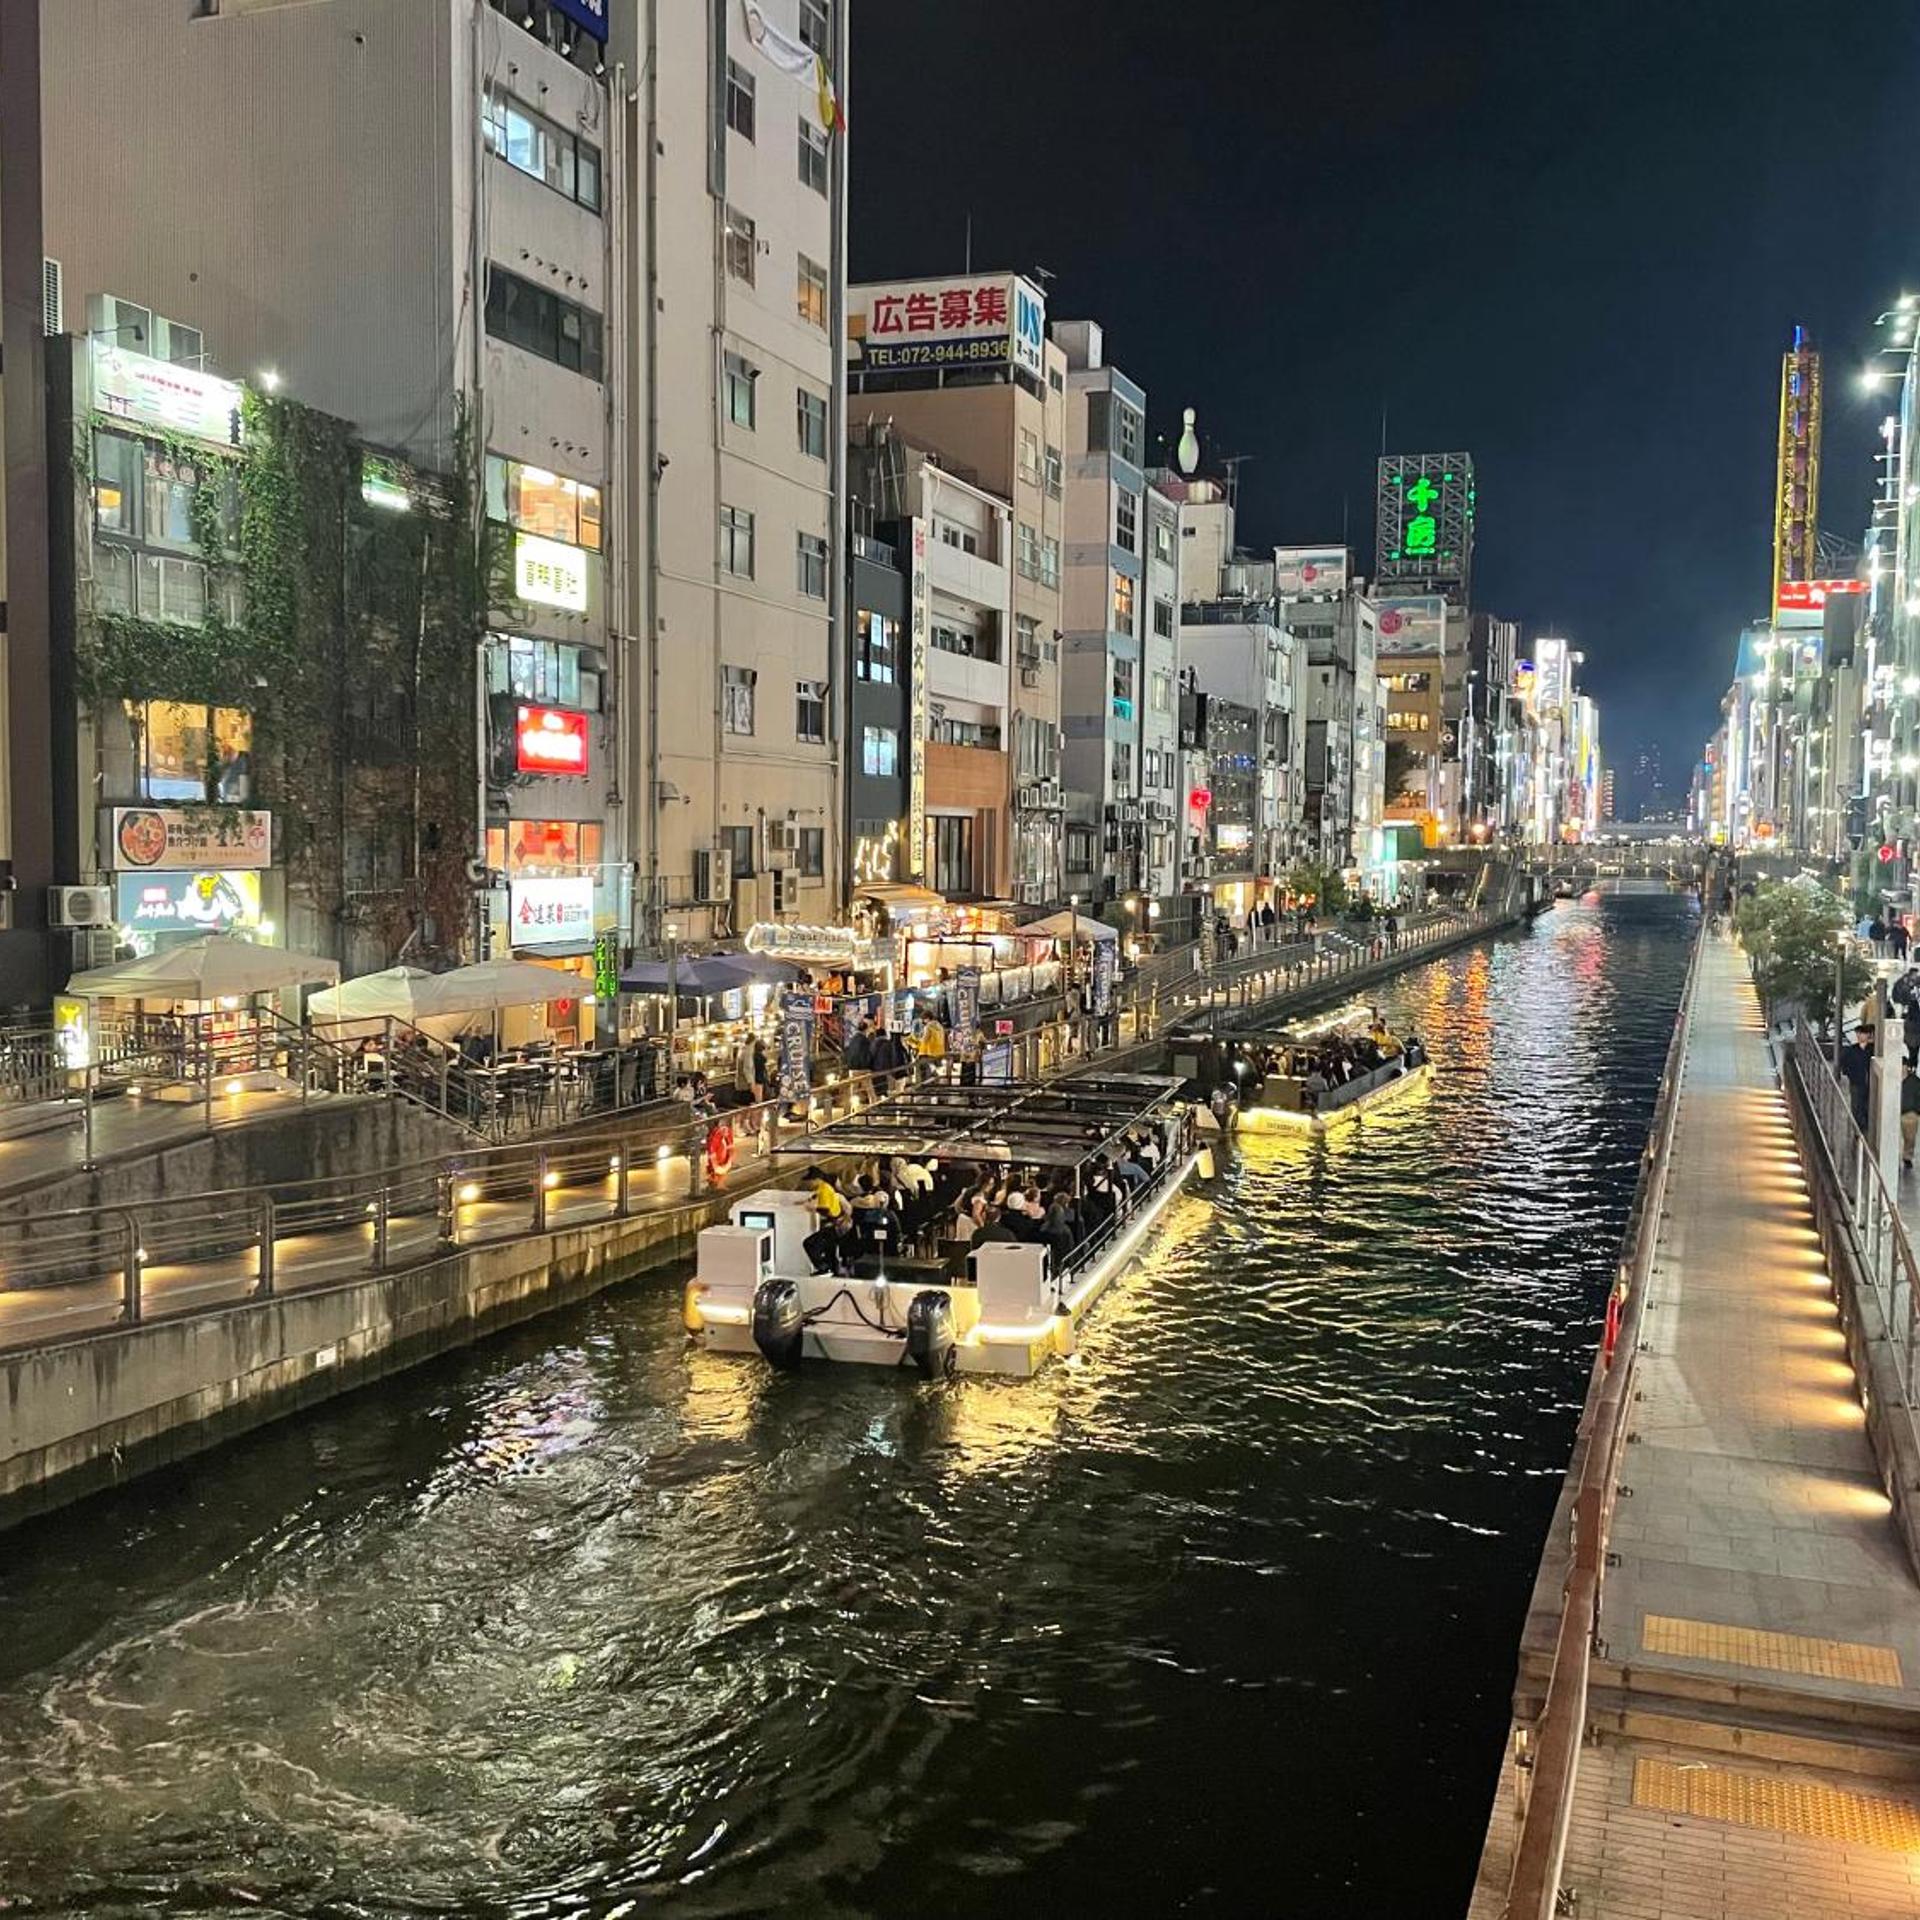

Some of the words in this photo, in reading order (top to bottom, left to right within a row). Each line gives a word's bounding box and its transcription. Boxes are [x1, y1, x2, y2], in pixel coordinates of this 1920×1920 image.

[872, 286, 1007, 334] 広告募集
[786, 1022, 809, 1091] CRUISE
